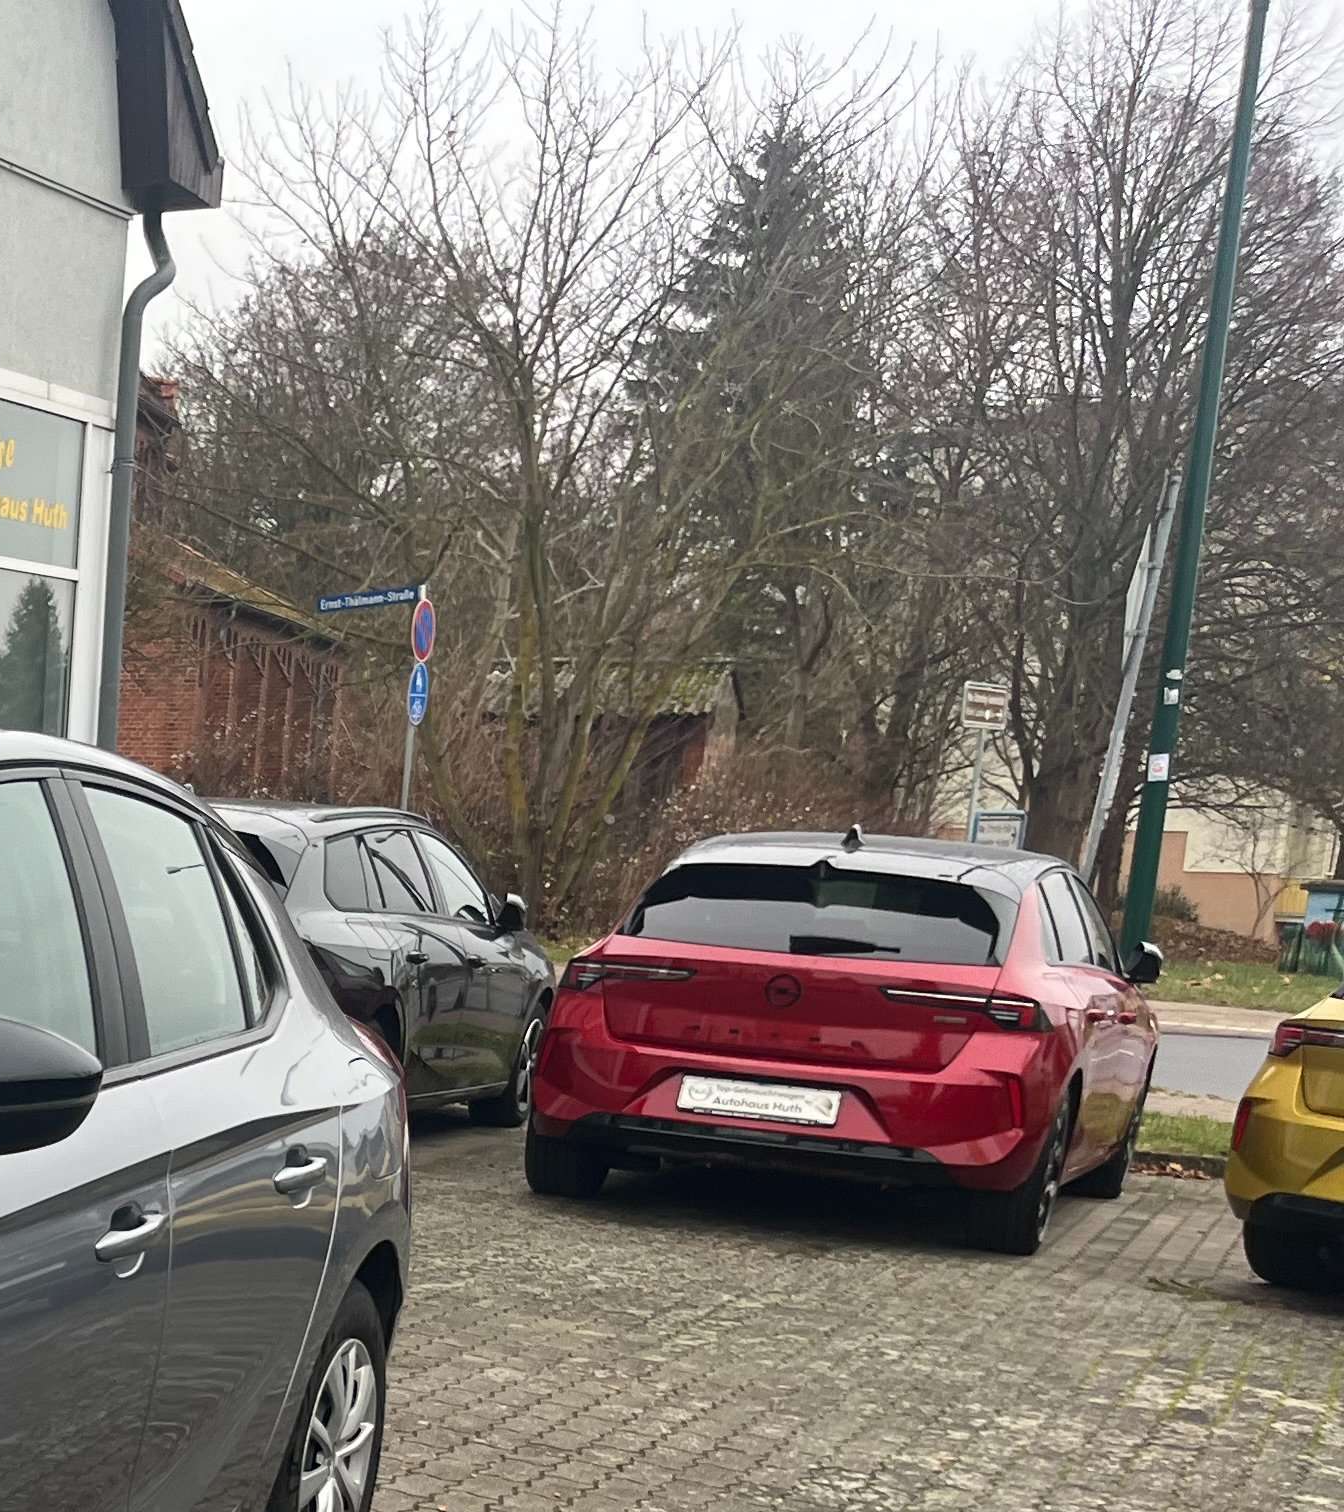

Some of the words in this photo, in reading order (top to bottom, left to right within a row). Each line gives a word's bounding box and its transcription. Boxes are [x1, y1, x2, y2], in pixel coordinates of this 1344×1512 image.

[32, 498, 70, 529] Huth
[712, 1096, 768, 1111] Autohaus
[772, 1101, 802, 1113] Huth
